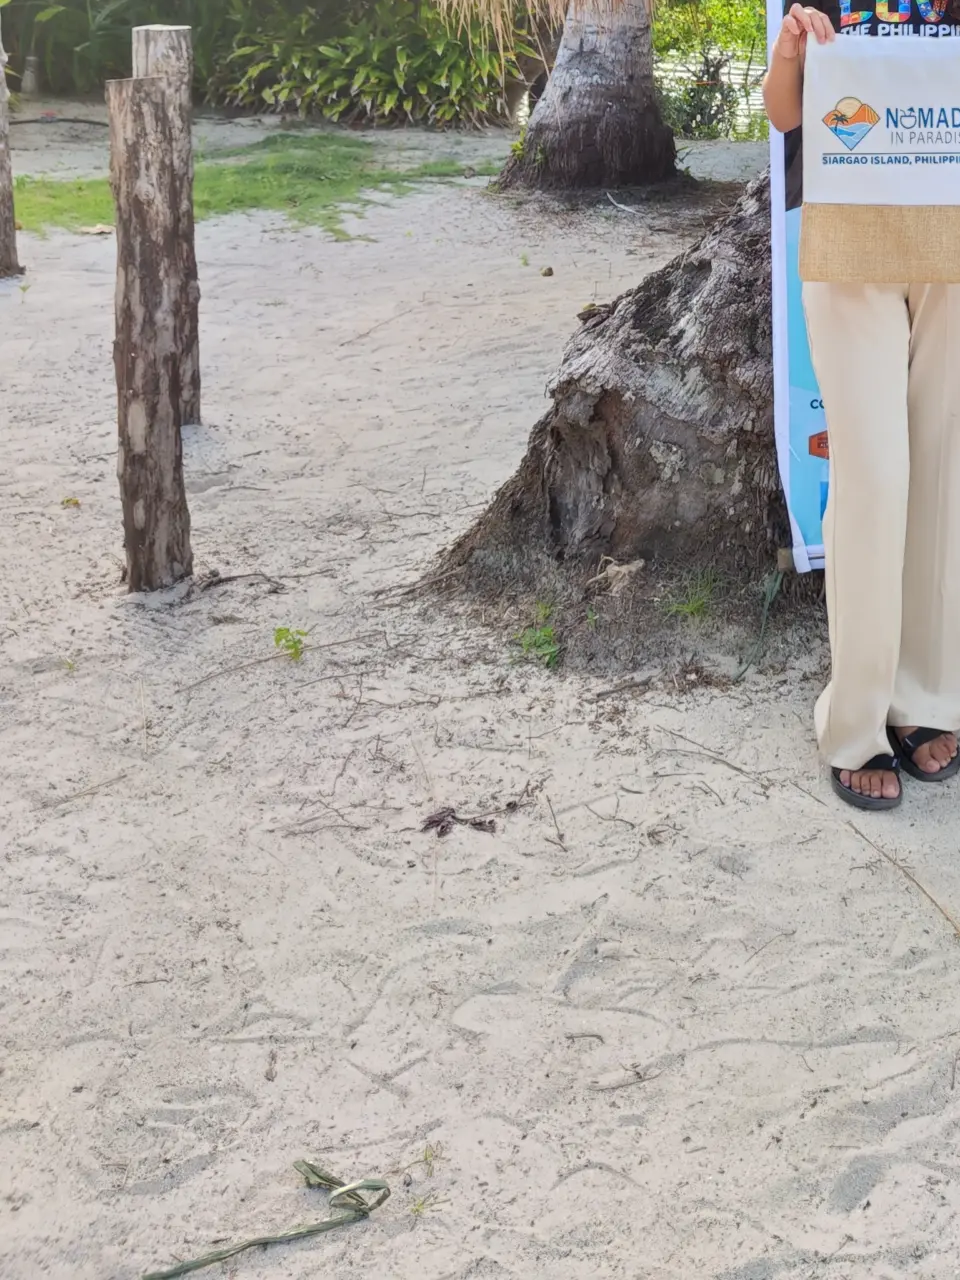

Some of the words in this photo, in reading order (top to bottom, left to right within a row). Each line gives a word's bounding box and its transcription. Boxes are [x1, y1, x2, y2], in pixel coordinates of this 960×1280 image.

[891, 132, 904, 145] IN
[822, 156, 868, 165] SIARGAO
[871, 155, 912, 166] ISLAND,
